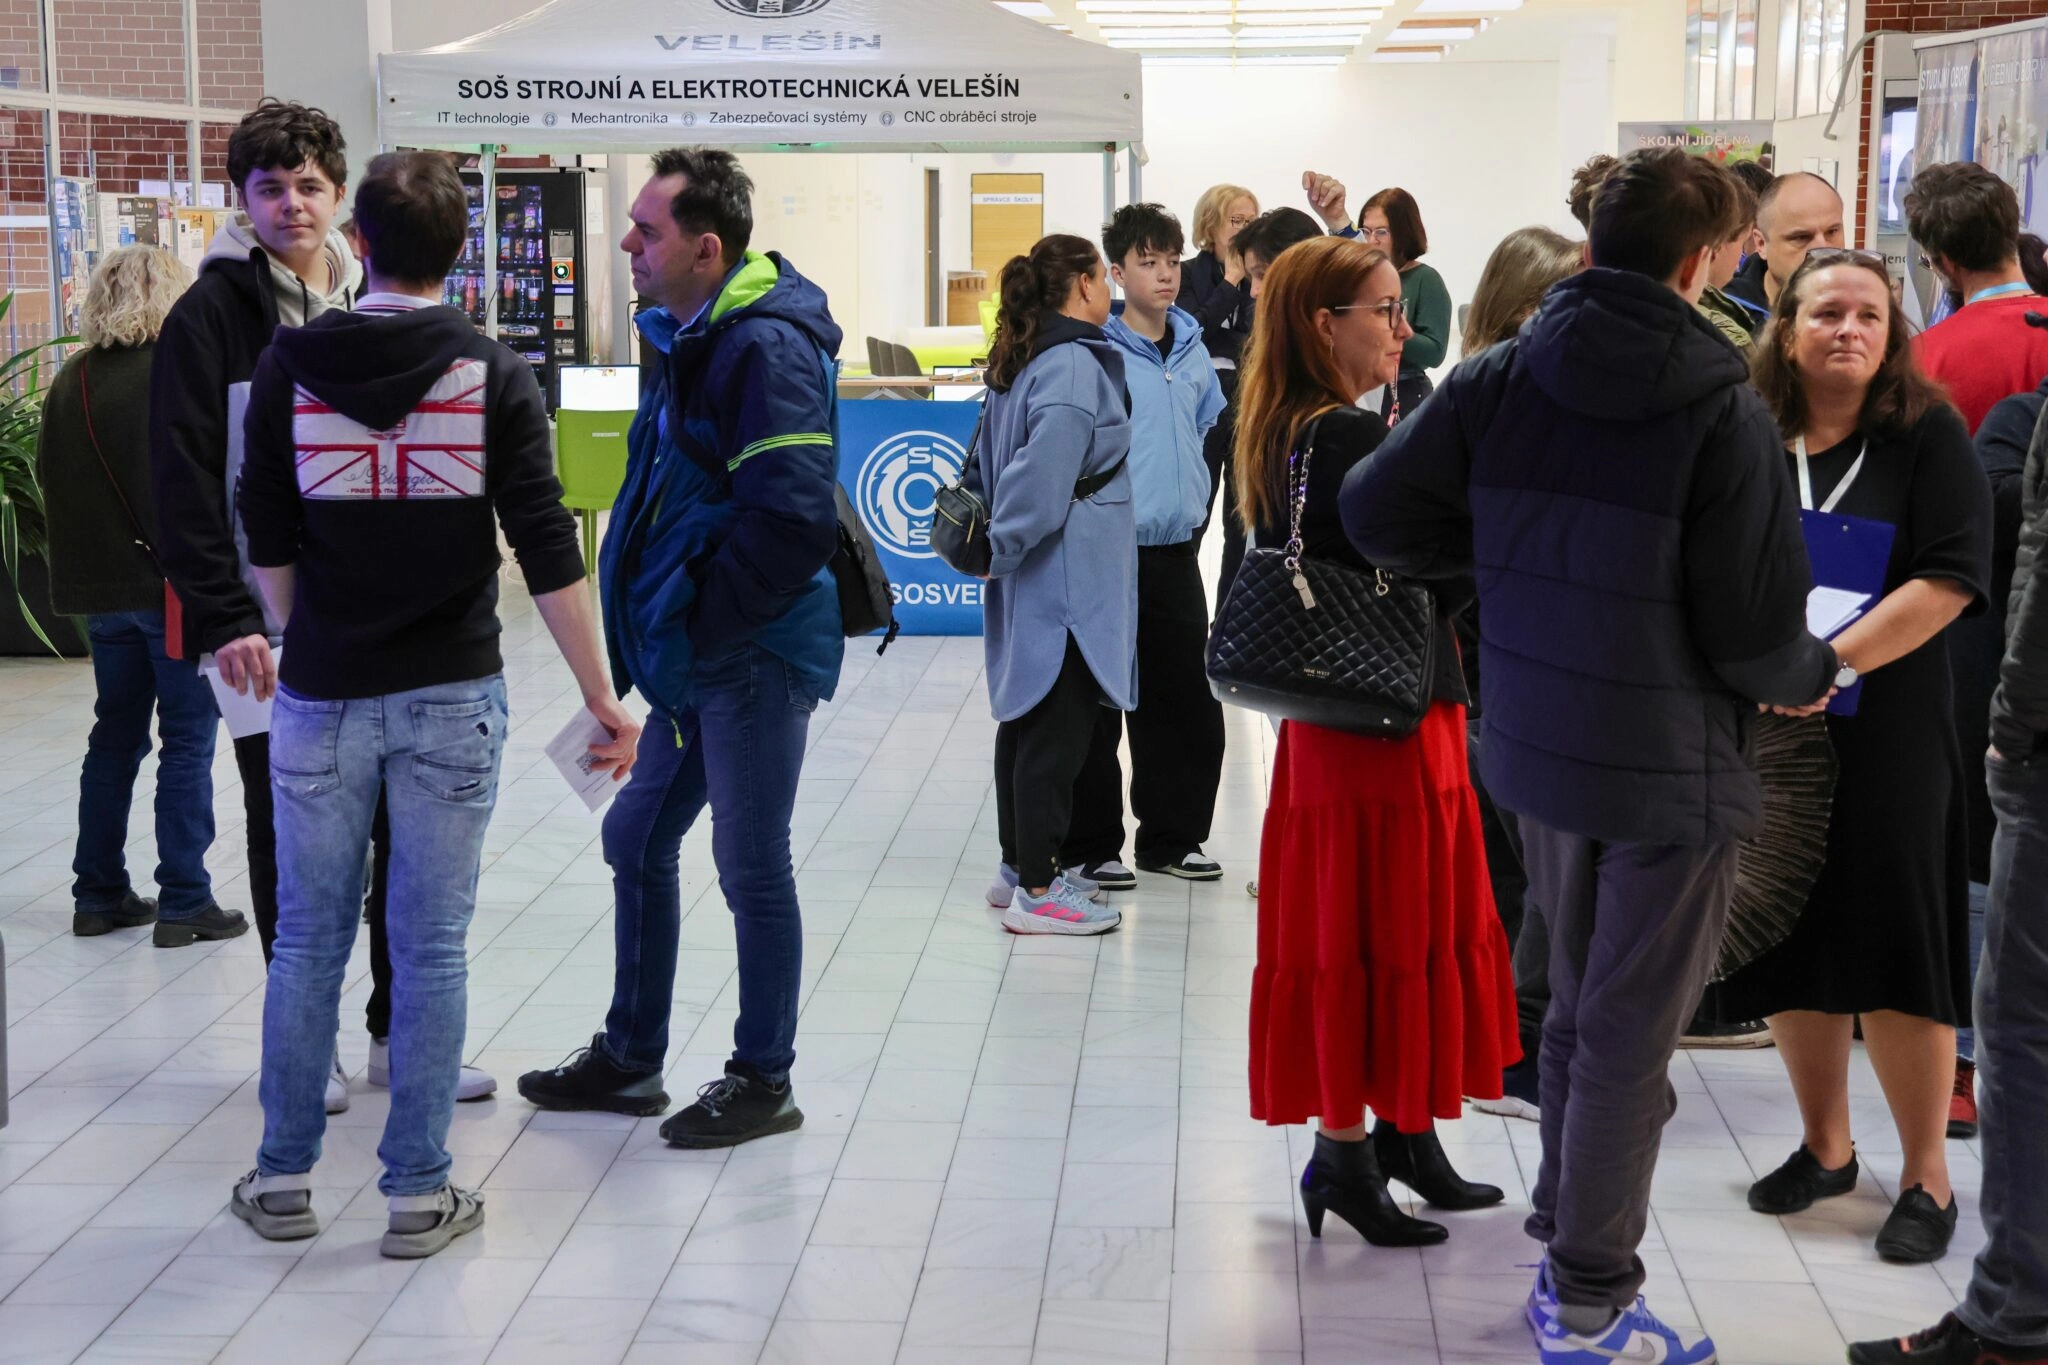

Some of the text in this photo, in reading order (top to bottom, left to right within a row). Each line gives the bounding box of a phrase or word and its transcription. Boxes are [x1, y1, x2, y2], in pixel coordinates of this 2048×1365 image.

[654, 29, 881, 51] VELEŠÍN
[457, 73, 1020, 100] SOŠ STROJNÍ A ELEKTROTECHNICKÁ VELEŠÍN
[438, 109, 1037, 127] IT technologie Mechantronika Zabezpečovací systémy CNC obráběcí stroje
